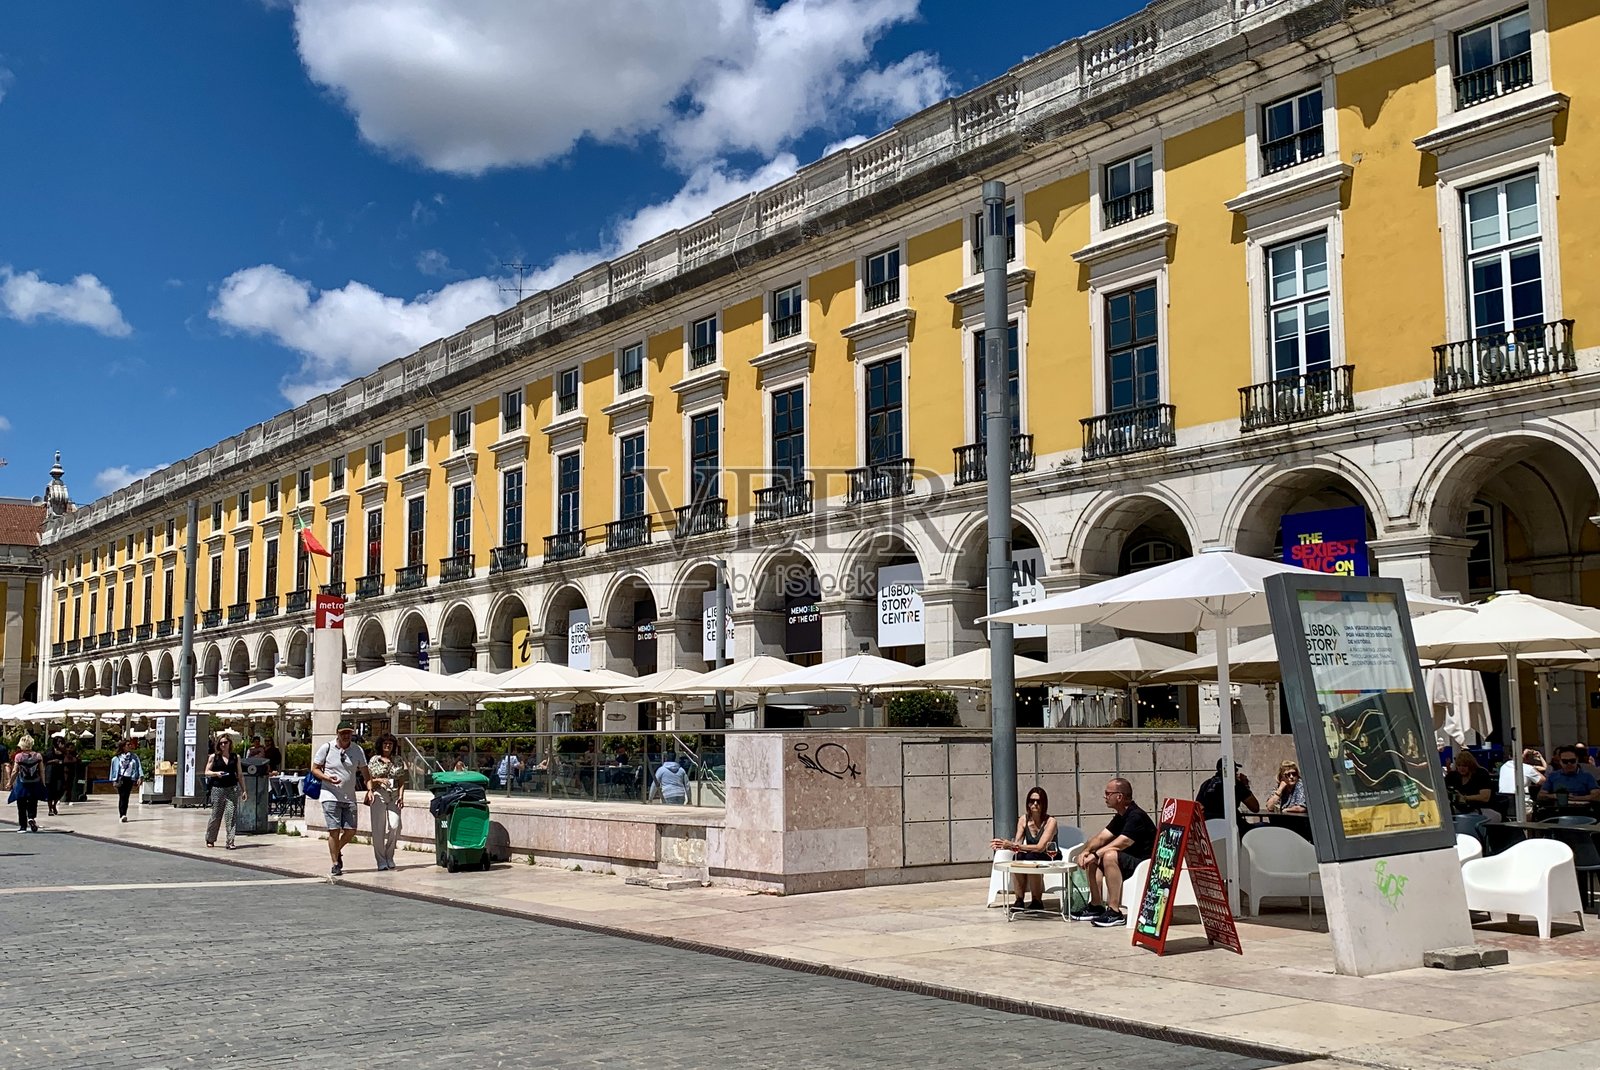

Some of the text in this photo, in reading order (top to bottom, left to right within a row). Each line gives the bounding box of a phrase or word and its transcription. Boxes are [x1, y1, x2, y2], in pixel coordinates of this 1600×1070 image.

[1298, 532, 1323, 545] THE
[1291, 540, 1358, 560] SEXIEST
[1302, 556, 1336, 574] WC
[1335, 560, 1354, 572] ON
[1012, 559, 1036, 587] AN
[881, 583, 917, 598] LISBOA
[319, 601, 344, 611] metro
[790, 604, 819, 615] MEMORIES
[881, 597, 913, 611] STORY
[789, 616, 796, 624] OF
[797, 615, 808, 623] THE
[881, 610, 920, 625] CENTRE
[706, 629, 734, 641] CERE
[571, 644, 590, 654] CENTR
[1305, 638, 1337, 651] STORY
[1309, 653, 1349, 666] CENTRE
